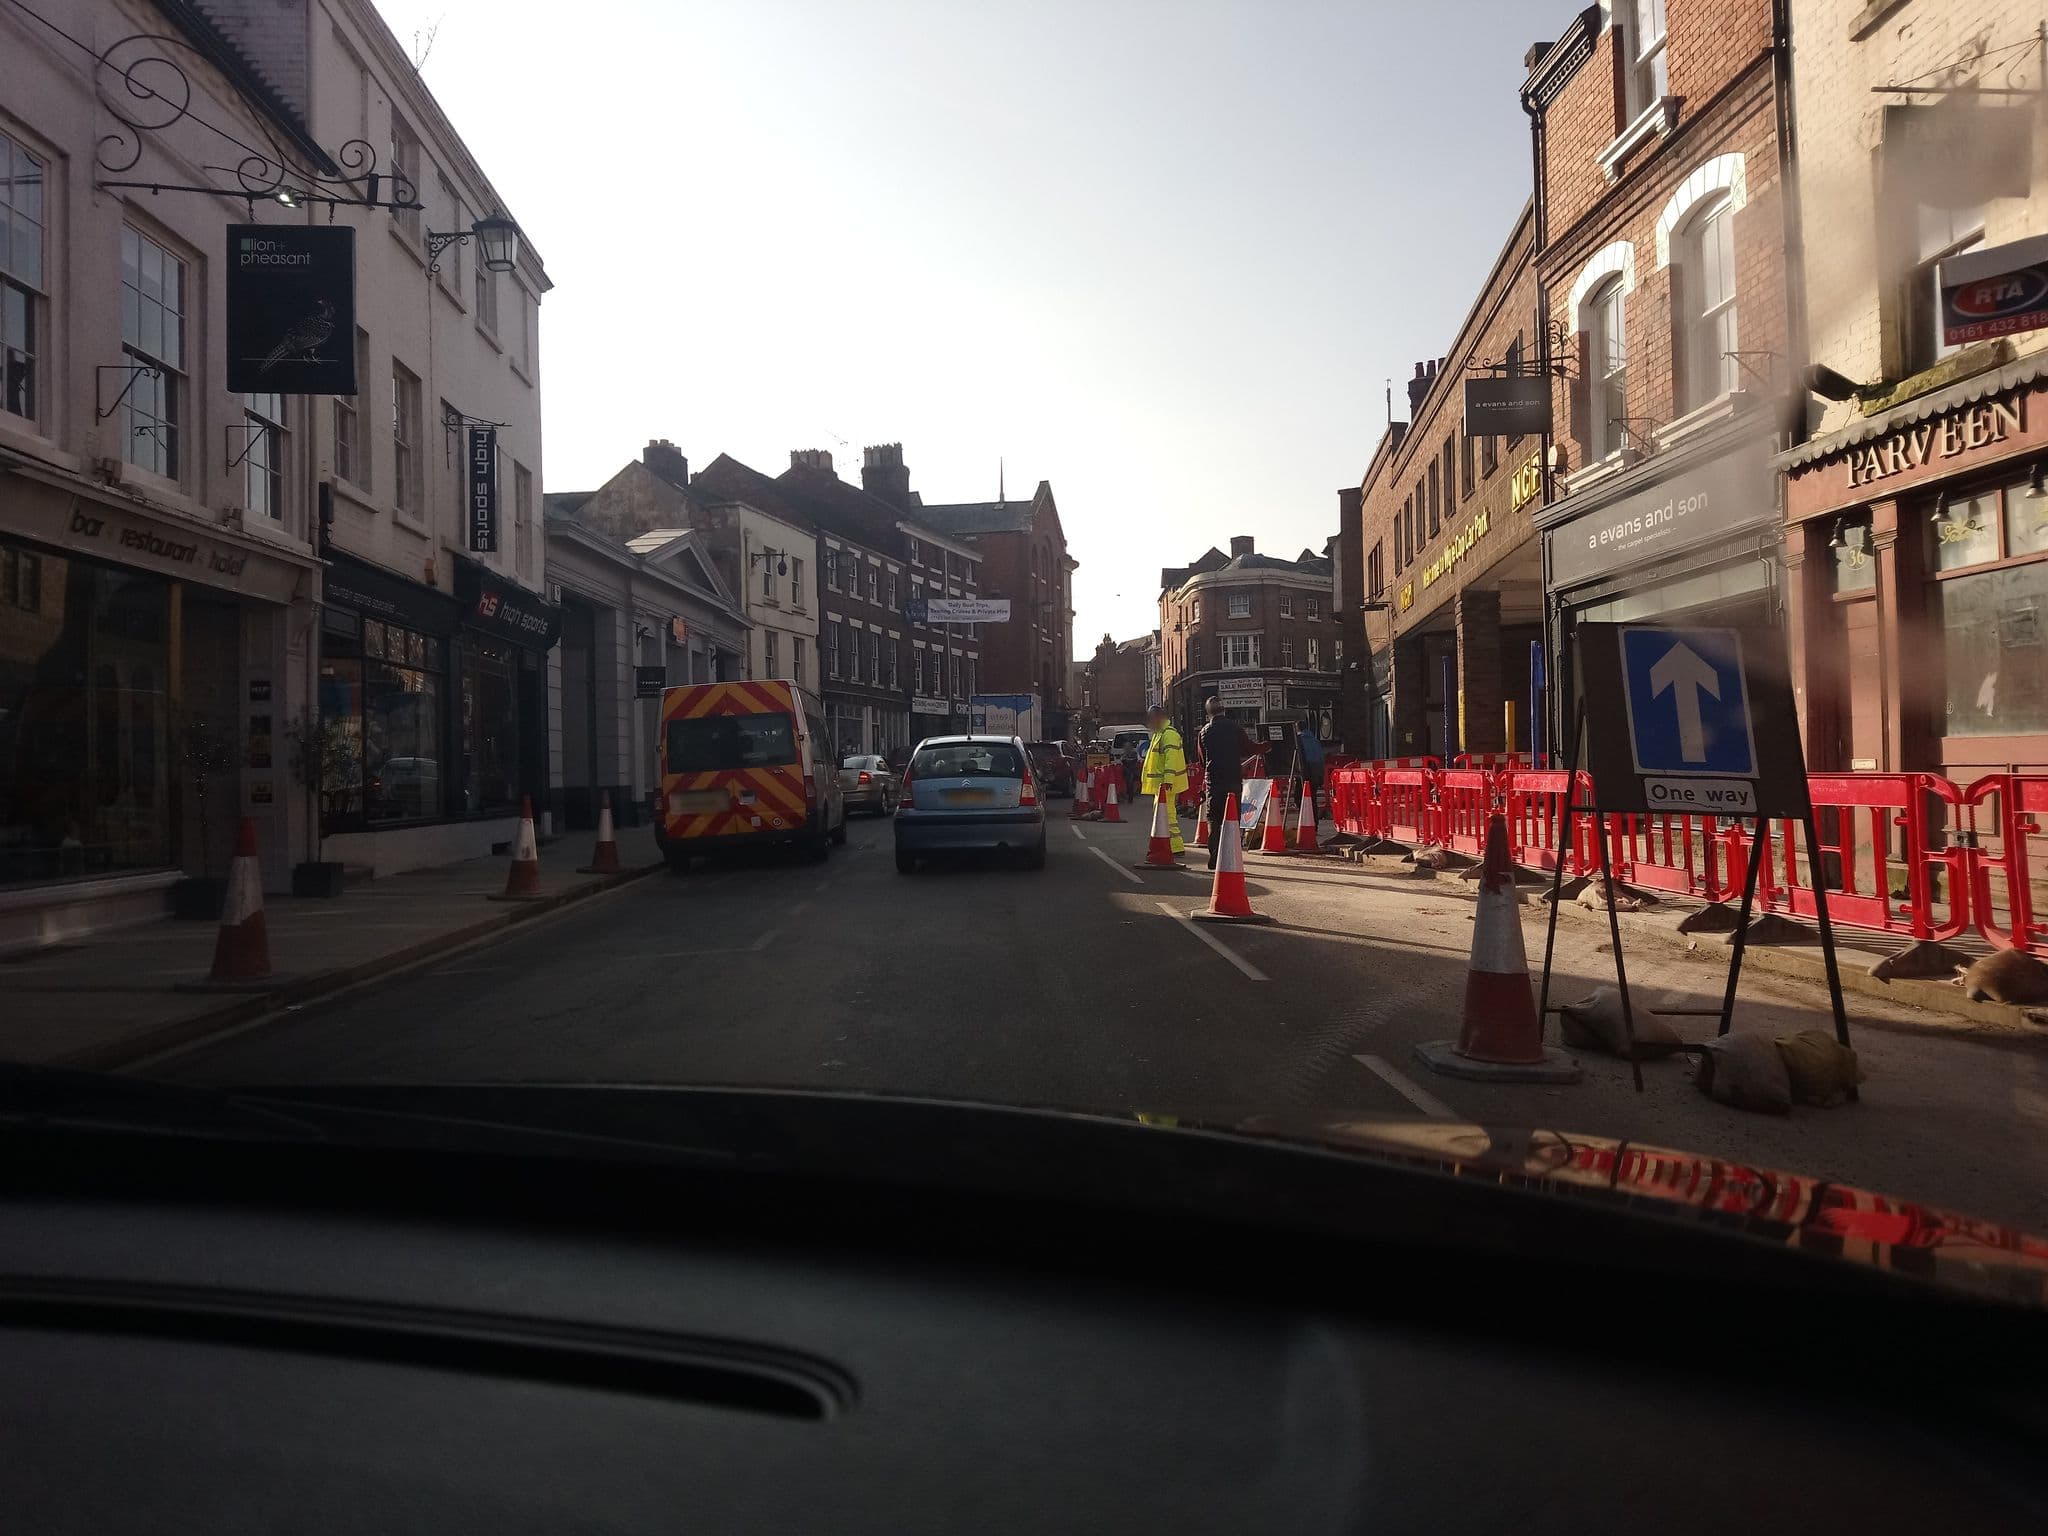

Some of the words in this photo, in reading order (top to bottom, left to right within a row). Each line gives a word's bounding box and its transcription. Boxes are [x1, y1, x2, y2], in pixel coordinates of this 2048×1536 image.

[240, 251, 312, 266] pheasant
[1974, 280, 2025, 306] RTA
[1950, 326, 1985, 342] 0161
[1989, 316, 2017, 332] 432
[1482, 400, 1506, 408] evans
[475, 430, 490, 474] high
[1846, 396, 2029, 489] PARVEEN
[475, 482, 490, 550] sports
[1588, 534, 1597, 549] a
[1600, 517, 1642, 545] evans
[1645, 499, 1673, 528] and
[1678, 491, 1708, 516] son
[71, 509, 104, 537] bar
[120, 527, 198, 564] restaurant
[208, 550, 247, 577] hotel
[1848, 549, 1865, 567] 36
[500, 601, 521, 625] high
[520, 611, 548, 636] sports
[1651, 784, 1695, 802] One
[1705, 789, 1749, 806] way
